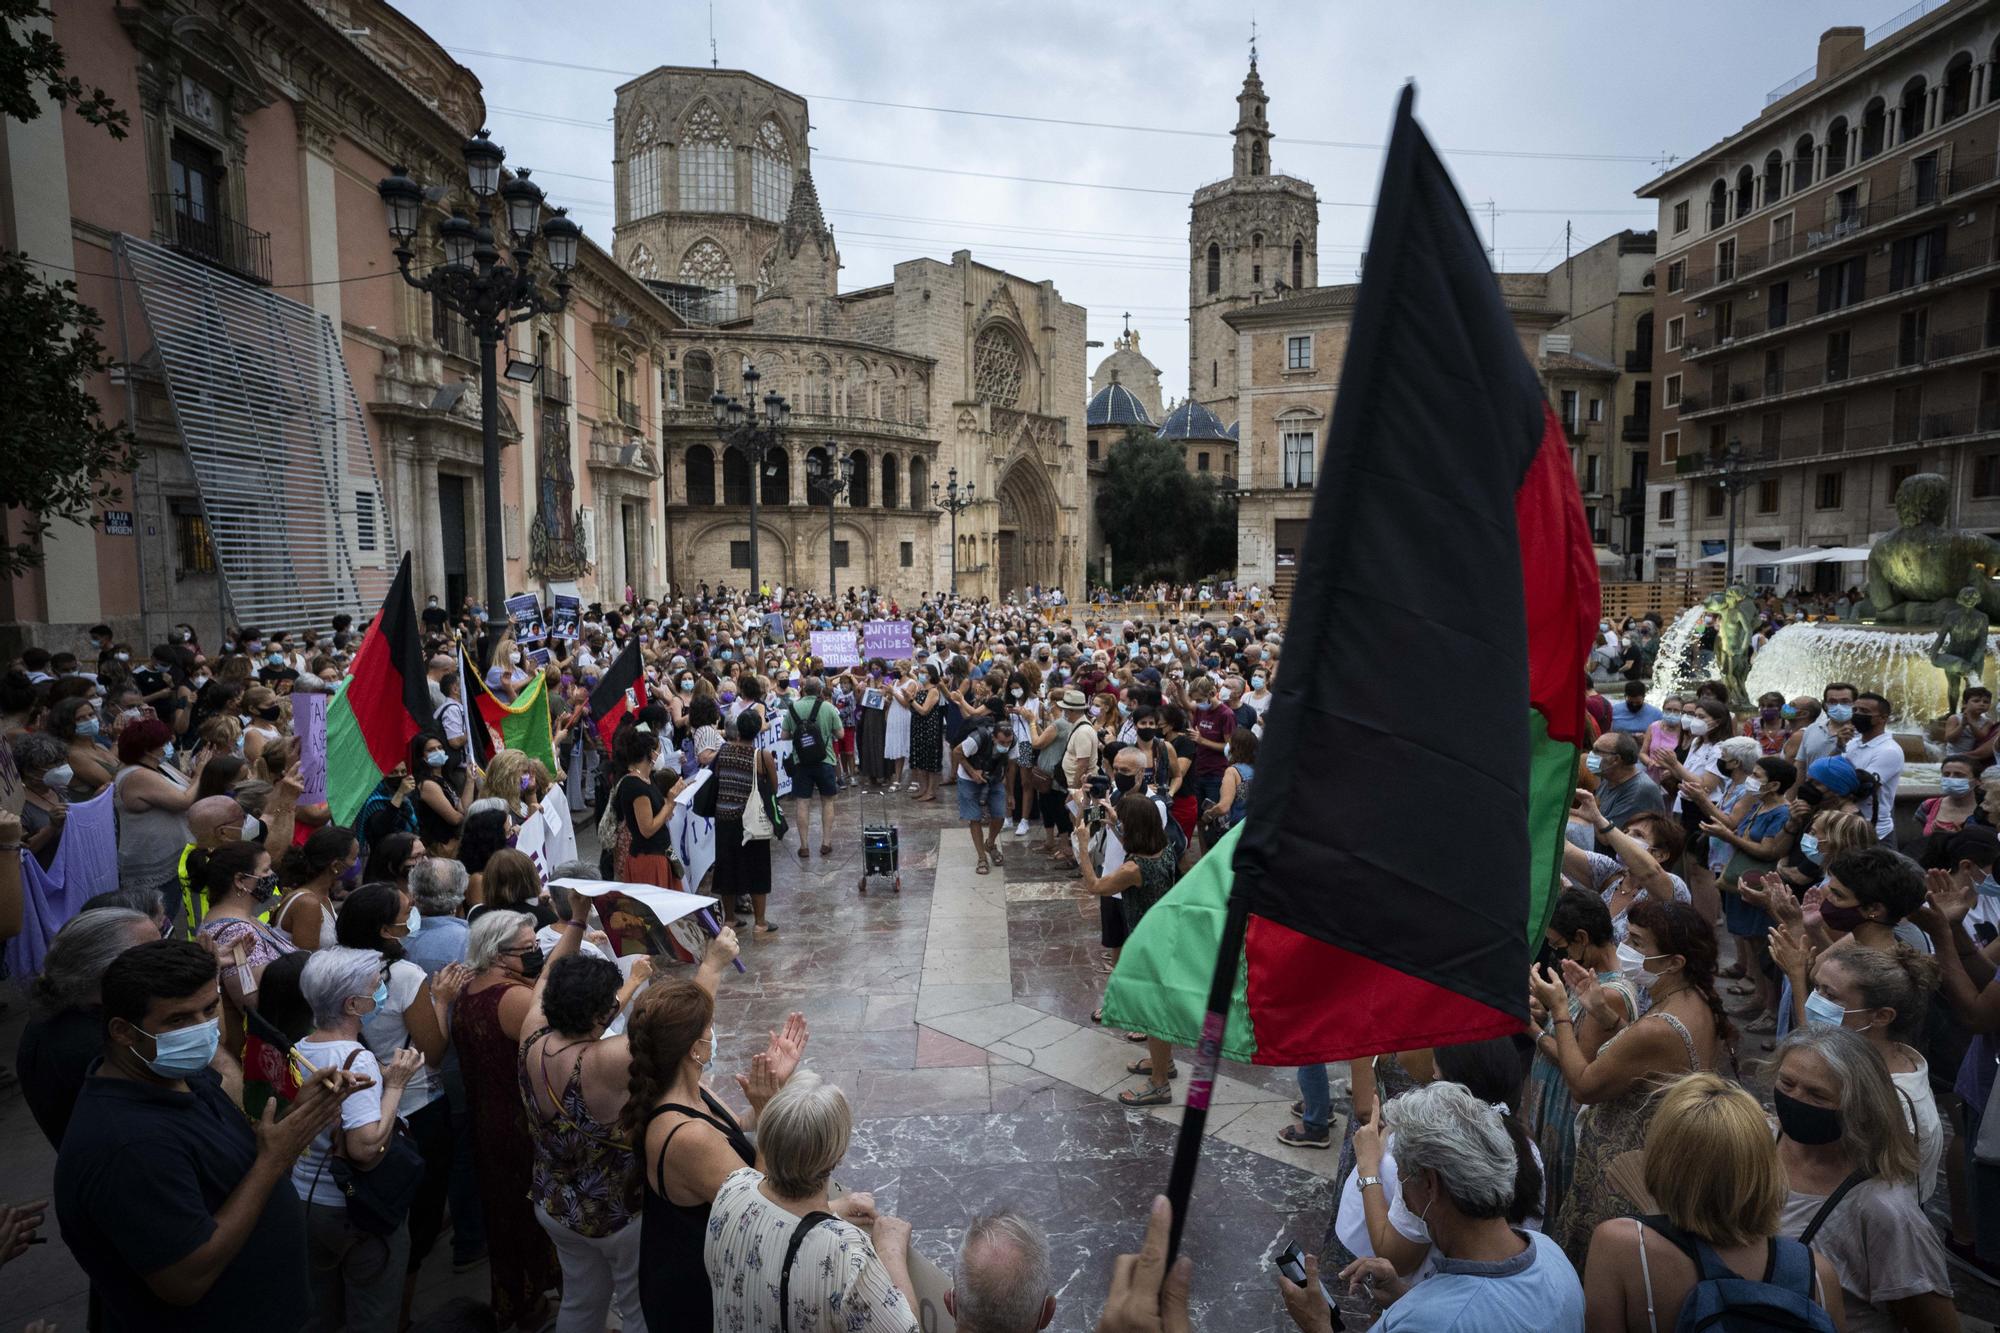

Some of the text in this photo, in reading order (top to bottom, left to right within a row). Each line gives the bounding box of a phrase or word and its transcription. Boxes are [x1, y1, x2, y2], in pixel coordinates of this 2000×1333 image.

[108, 511, 128, 520] PLAZA
[106, 526, 132, 535] VIRGEN
[864, 624, 909, 636] JUNTES
[822, 643, 854, 653] DONES
[866, 638, 910, 650] UNIDES
